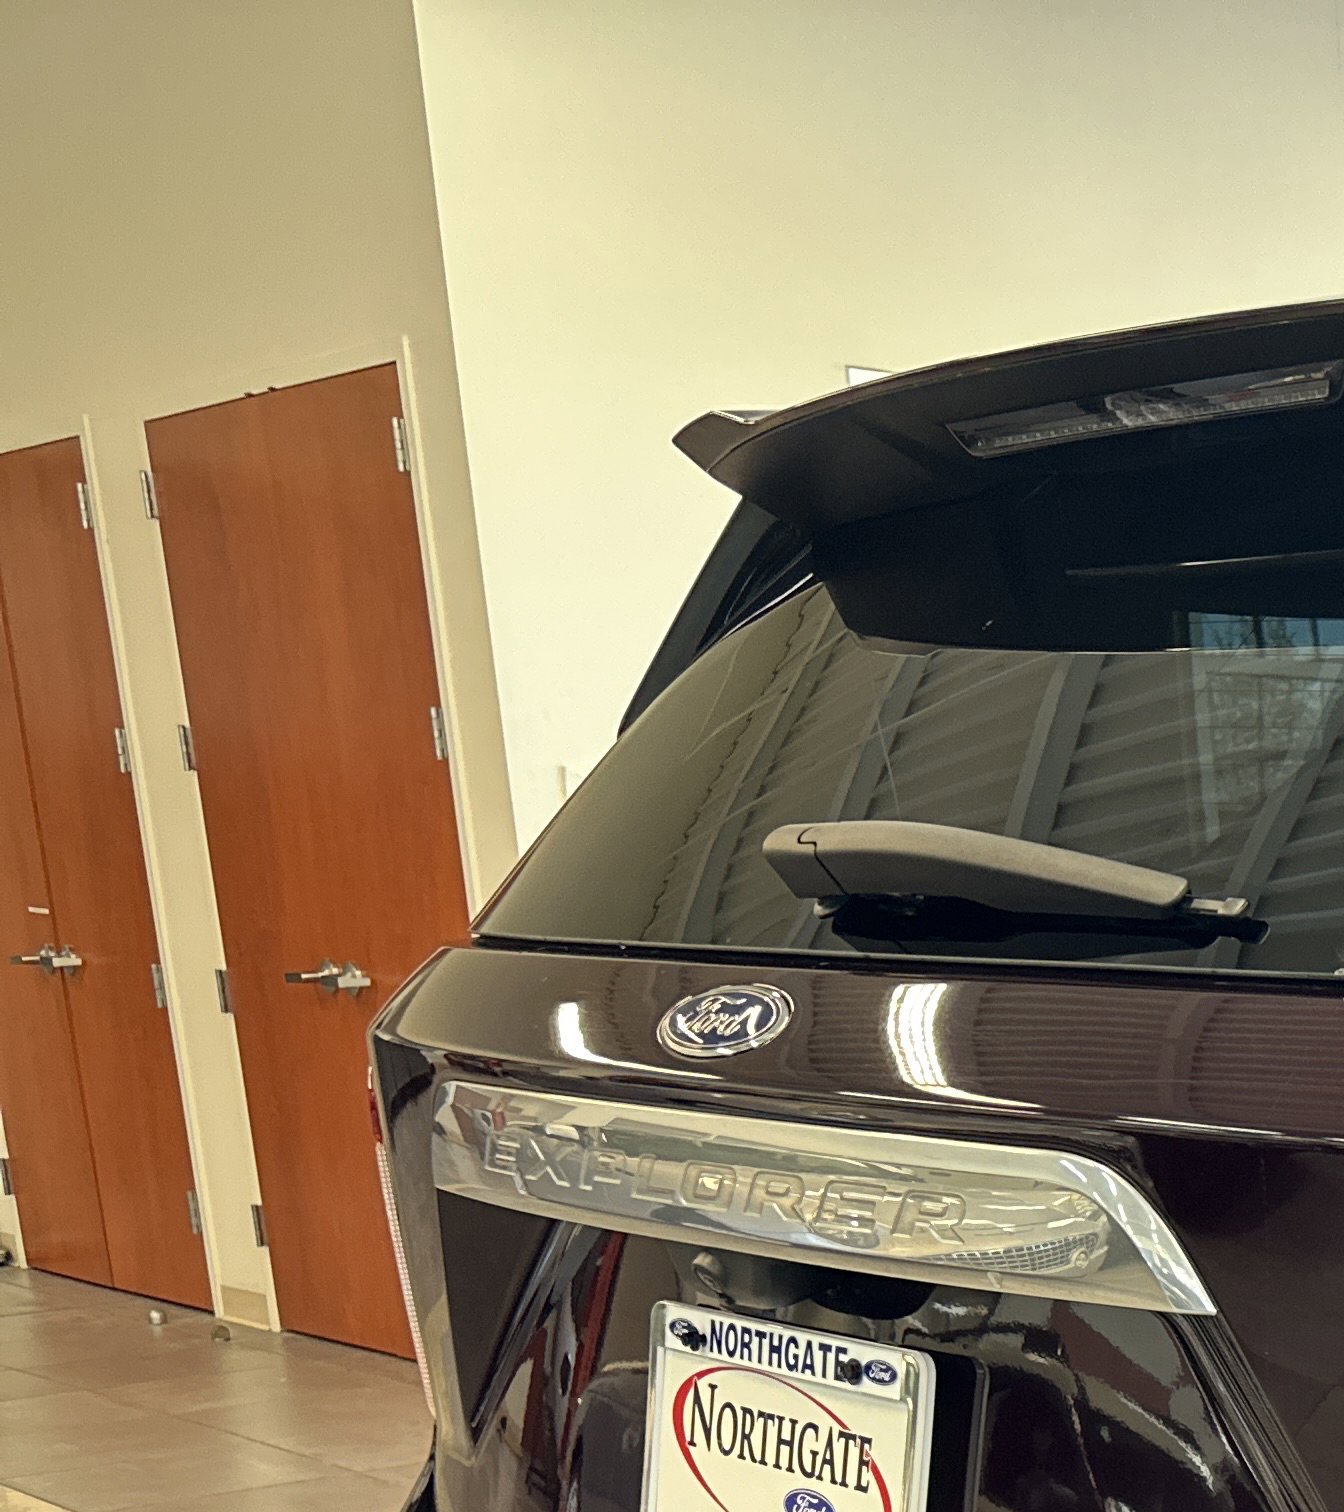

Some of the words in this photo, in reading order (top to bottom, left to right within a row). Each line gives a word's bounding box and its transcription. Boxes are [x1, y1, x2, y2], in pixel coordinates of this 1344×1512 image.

[483, 1126, 967, 1246] EXPLORER
[708, 1319, 848, 1384] NORTHGATE
[687, 1379, 873, 1494] NORTHGATE
